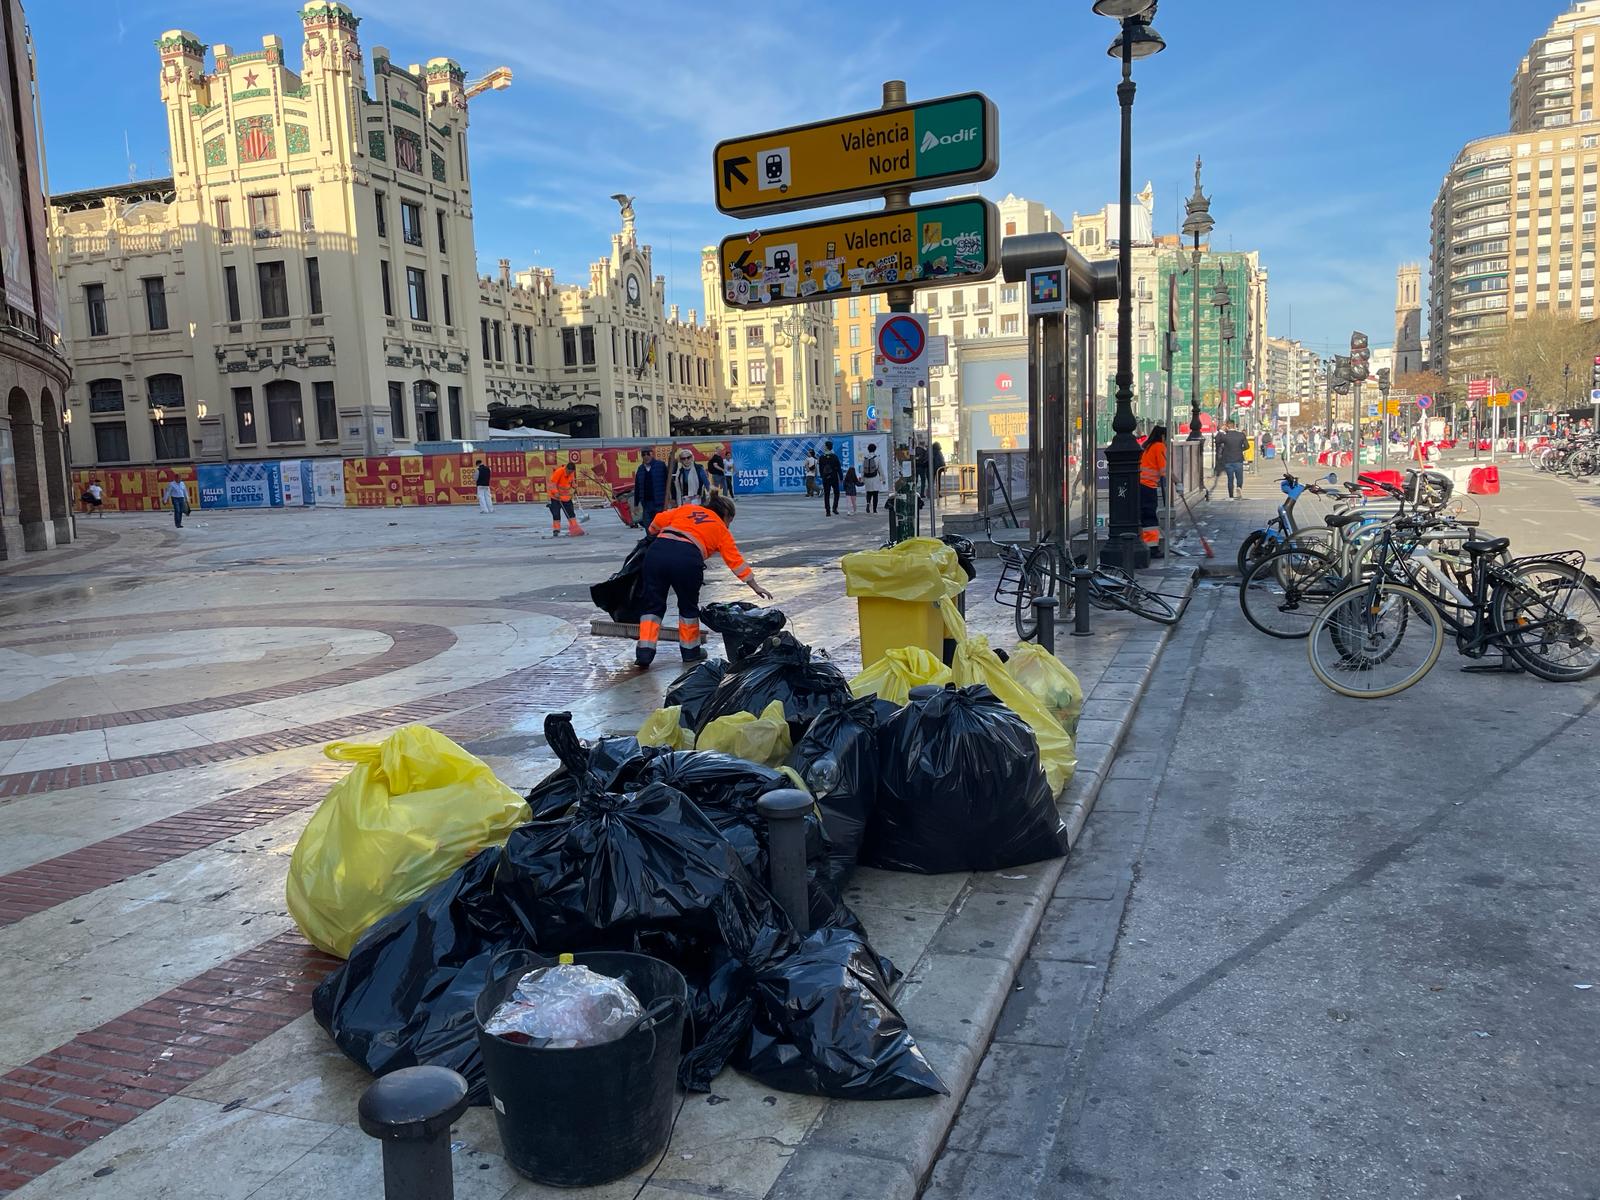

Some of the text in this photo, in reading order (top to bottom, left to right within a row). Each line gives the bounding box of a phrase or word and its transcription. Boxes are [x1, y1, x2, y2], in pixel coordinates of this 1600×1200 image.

[841, 122, 909, 152] València
[939, 127, 978, 146] adif
[869, 149, 910, 176] Nord
[844, 224, 912, 251] Valencia
[1001, 379, 1012, 388] m
[739, 470, 769, 478] FALLES
[738, 478, 760, 487] 2024
[202, 488, 224, 496] FALLES
[230, 485, 256, 494] BONES
